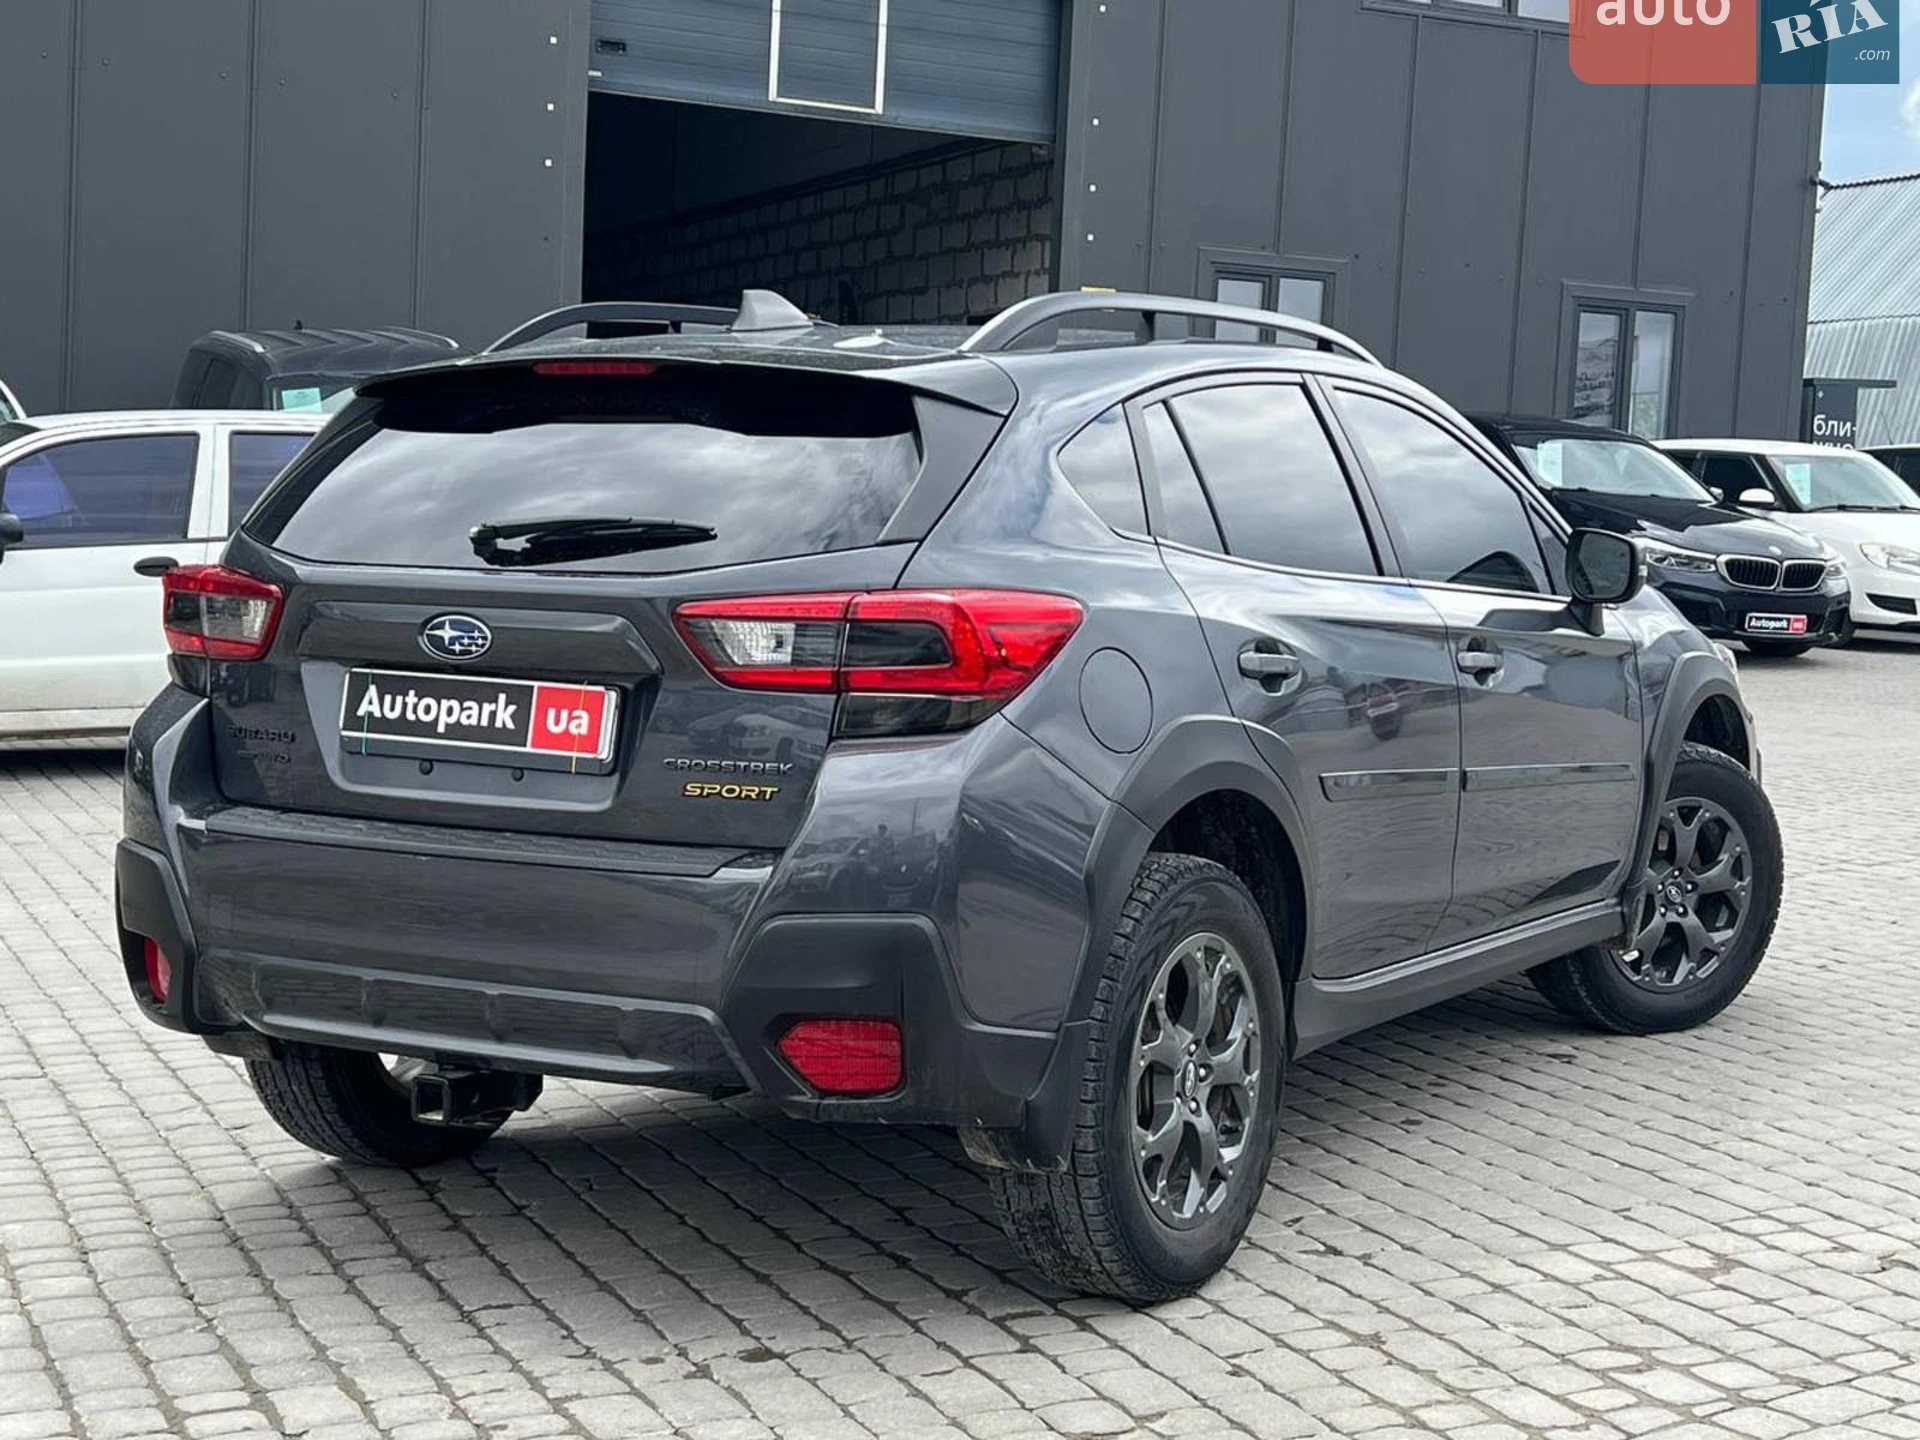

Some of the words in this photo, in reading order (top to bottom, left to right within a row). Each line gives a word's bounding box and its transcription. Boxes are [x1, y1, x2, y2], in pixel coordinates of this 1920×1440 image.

[1813, 414, 1857, 437] бли-
[1750, 617, 1788, 630] Autopark
[356, 684, 517, 733] Autopark
[545, 707, 590, 736] ua
[662, 757, 794, 775] CROSSTREK
[683, 782, 779, 801] SPORT
